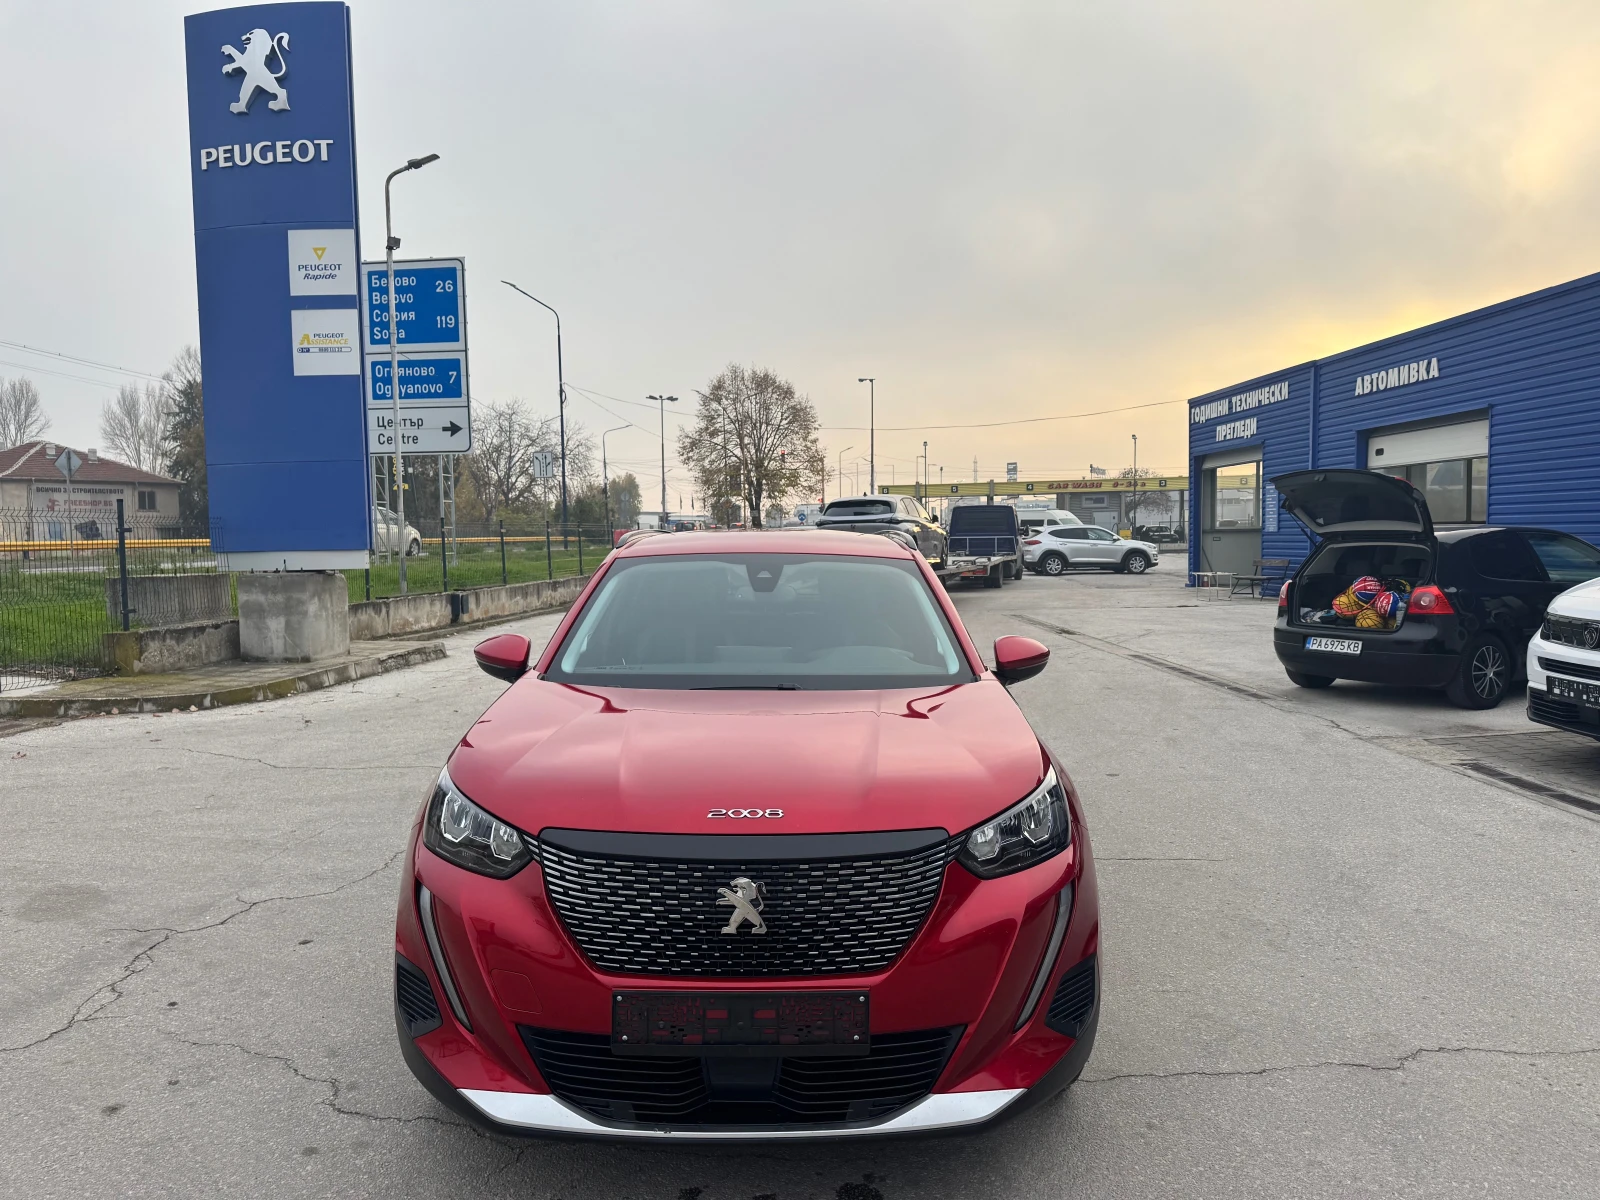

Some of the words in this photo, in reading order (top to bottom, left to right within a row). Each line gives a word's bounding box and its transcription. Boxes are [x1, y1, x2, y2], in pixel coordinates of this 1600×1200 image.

[200, 139, 334, 171] PEUGEOT
[297, 263, 342, 272] PEUGEOT
[303, 272, 337, 281] Rapide
[371, 275, 417, 288] Беово
[435, 280, 454, 293] 26
[372, 292, 414, 305] Beovo
[436, 315, 455, 329] 119
[373, 326, 406, 340] Soia
[375, 364, 435, 378] Огяново
[449, 371, 457, 384] 7
[1354, 357, 1440, 397] АВТОМИВКА
[376, 381, 443, 397] Ogyanovo
[1191, 398, 1229, 424] ГОДИШНИ
[1231, 381, 1289, 413] ТЕХНИЧЕСКИ
[1215, 417, 1257, 442] ПРЕГЛЕДИ
[377, 432, 419, 446] Cetre
[1071, 481, 1103, 489] WASH
[706, 808, 785, 819] 2008
